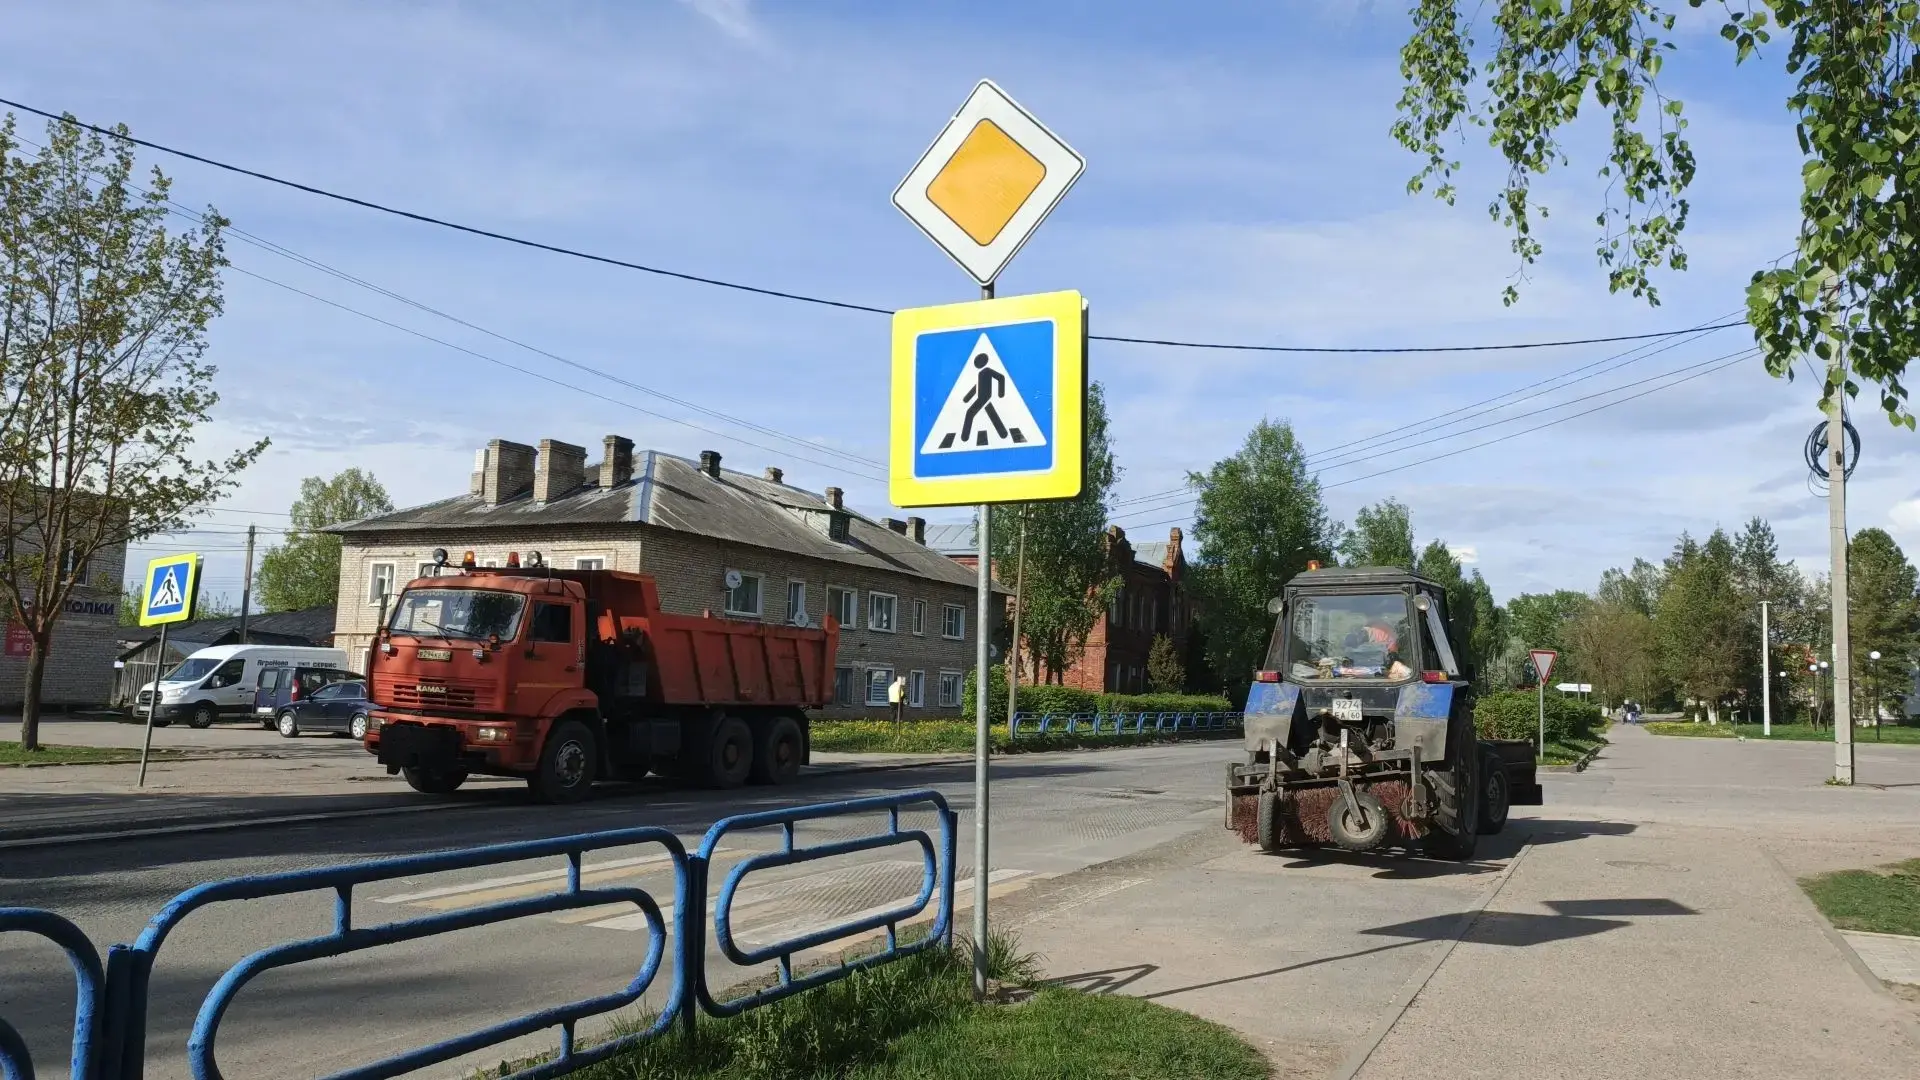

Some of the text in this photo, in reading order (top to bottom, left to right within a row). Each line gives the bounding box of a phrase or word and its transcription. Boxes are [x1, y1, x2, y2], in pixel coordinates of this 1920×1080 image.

[63, 600, 114, 615] ТОЛКИ
[1335, 700, 1359, 709] 9274
[1350, 711, 1360, 719] 60
